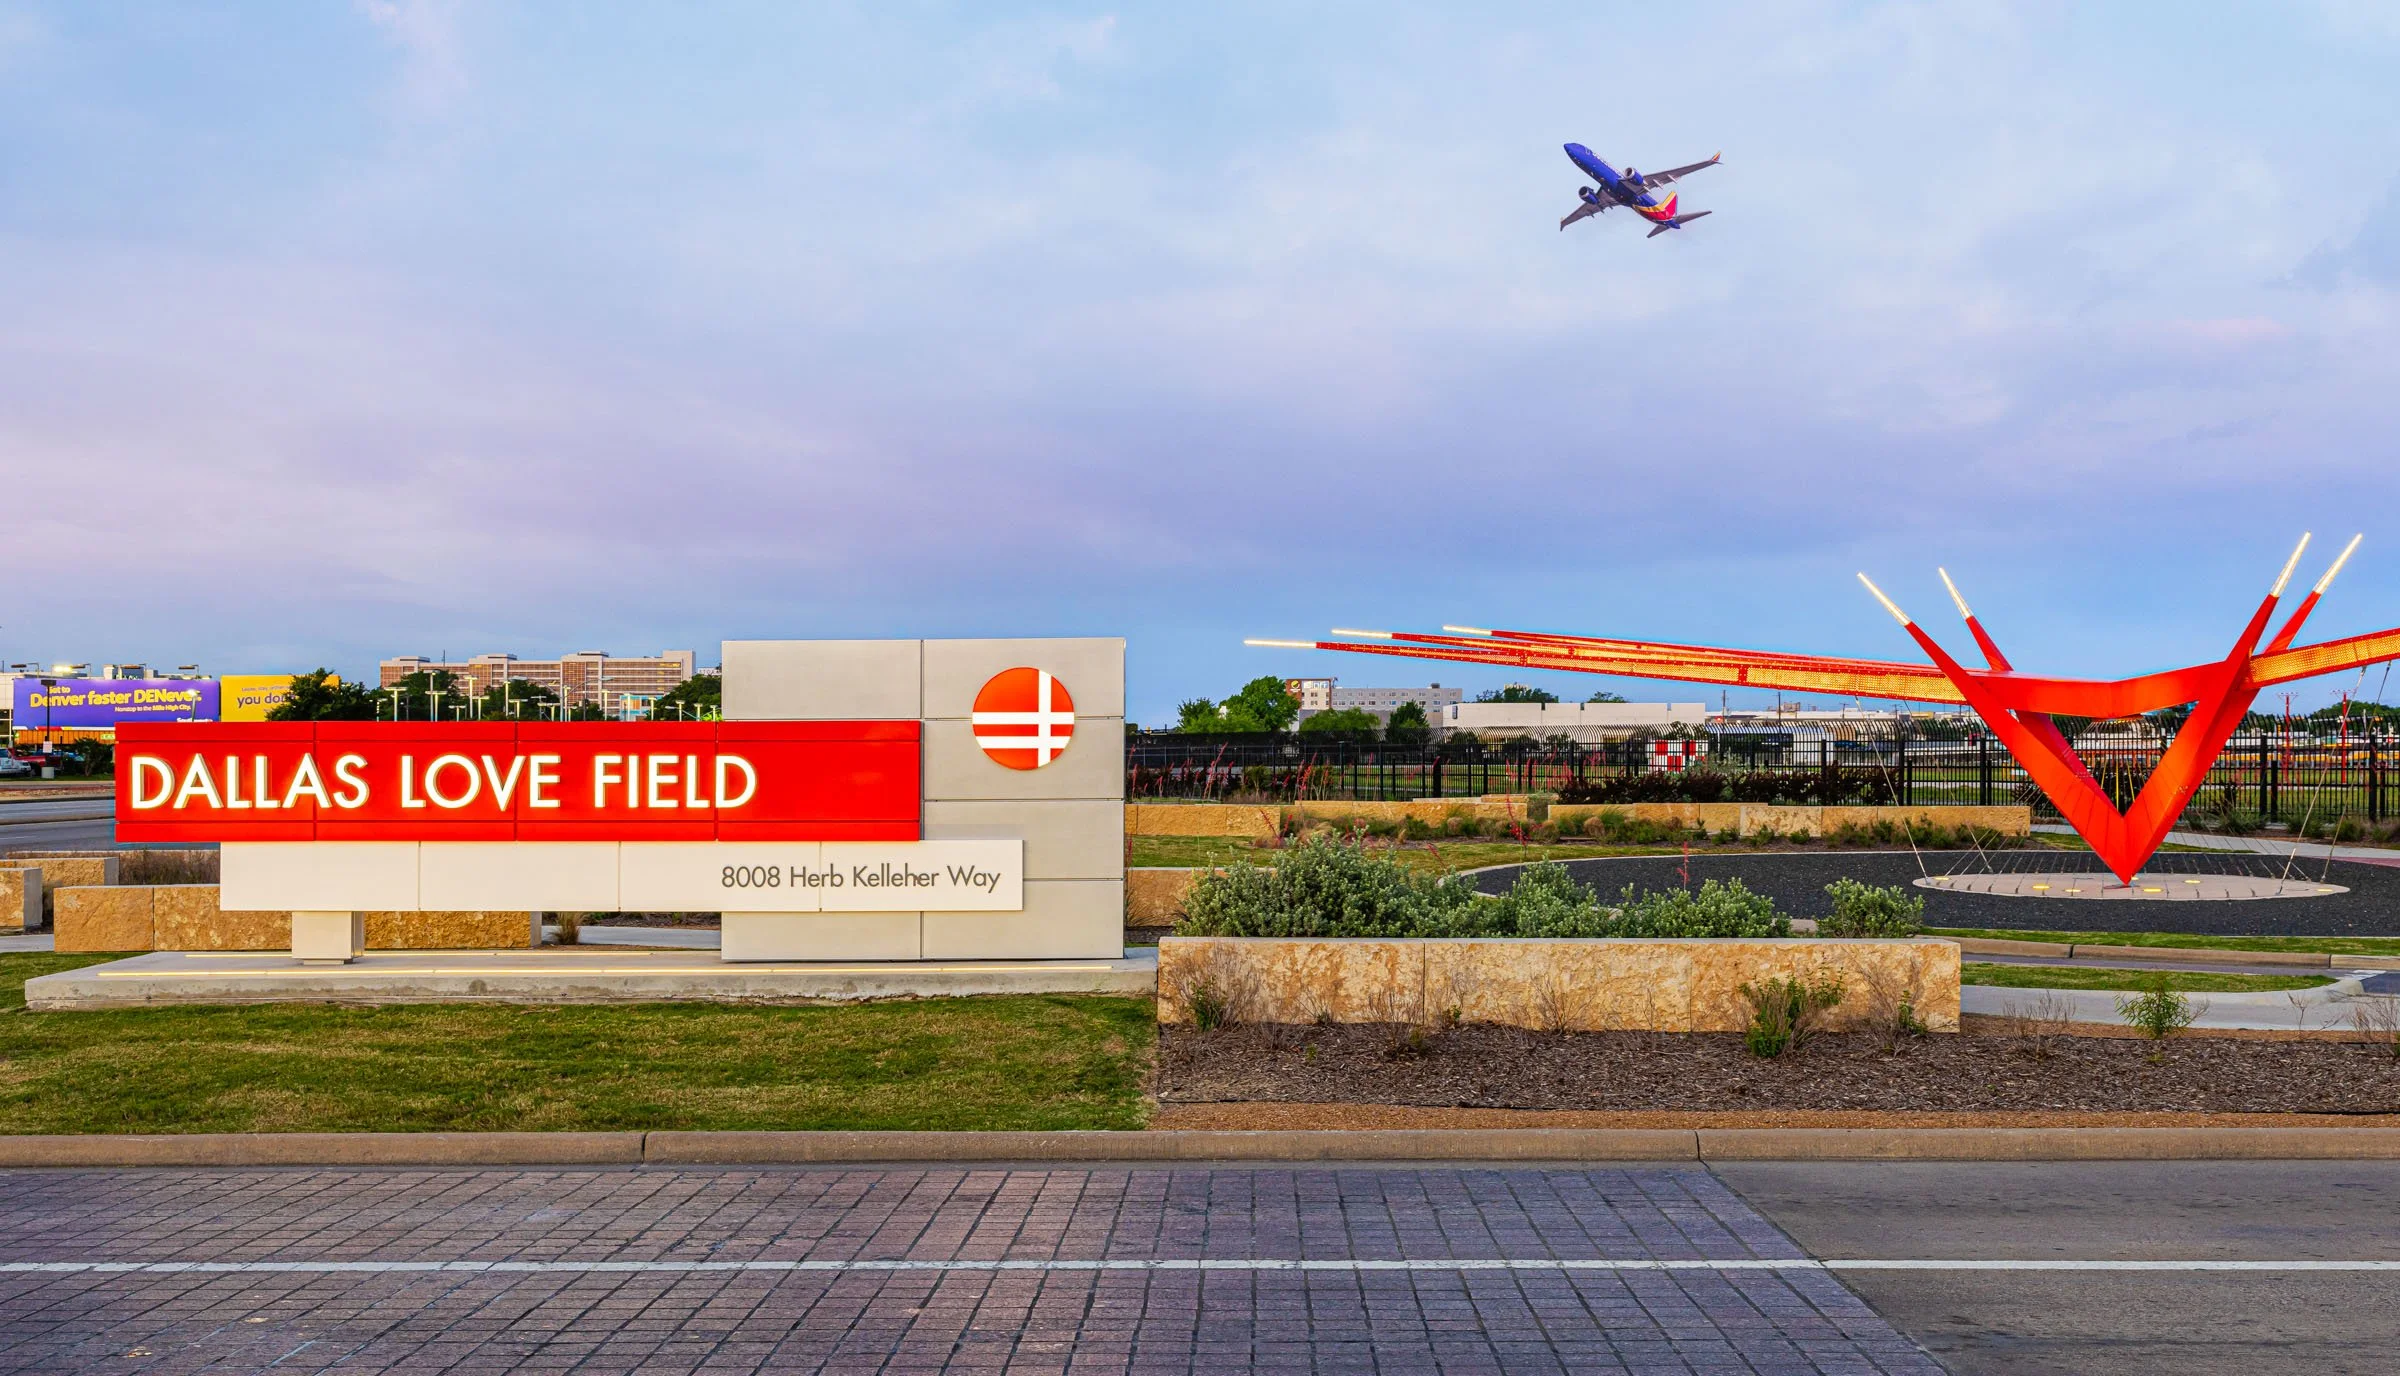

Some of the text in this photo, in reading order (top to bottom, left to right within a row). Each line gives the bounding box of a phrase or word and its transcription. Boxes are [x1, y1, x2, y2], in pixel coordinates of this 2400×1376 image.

[30, 693, 86, 707] Denver
[88, 690, 130, 705] faster
[237, 696, 261, 708] you
[131, 752, 758, 812] DALLAS LOVE FIELD
[721, 862, 1001, 894] 8008 Herb Kelleher Way
